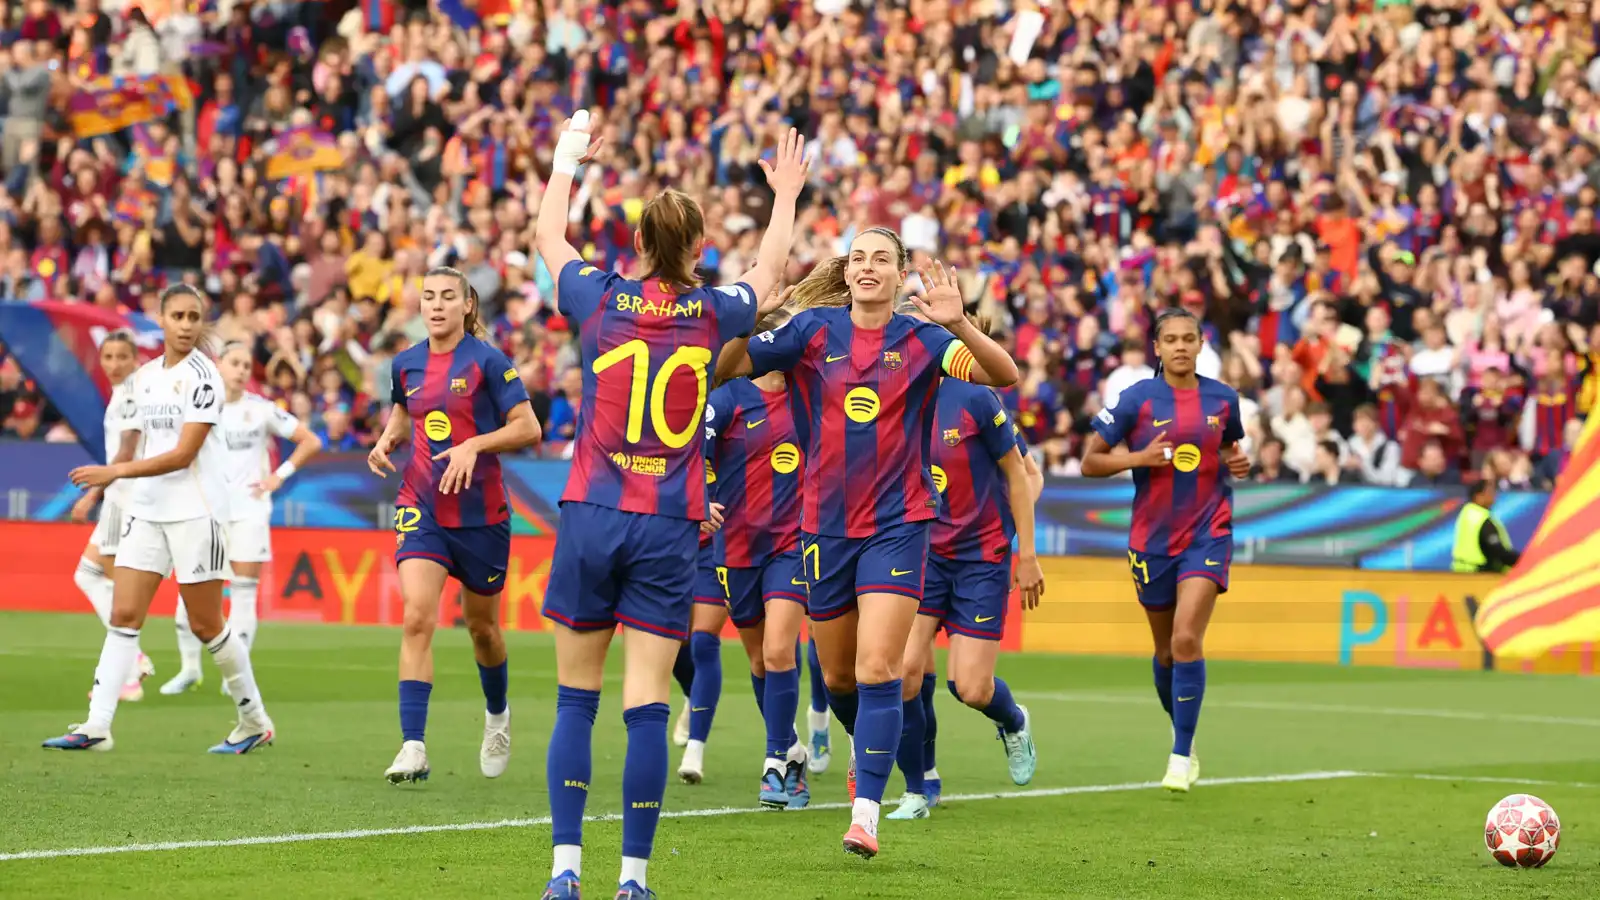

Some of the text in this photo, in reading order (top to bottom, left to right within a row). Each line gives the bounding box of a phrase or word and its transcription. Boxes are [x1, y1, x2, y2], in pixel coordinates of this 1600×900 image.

[592, 339, 713, 449] 10
[631, 464, 667, 474] ACNUR
[632, 455, 667, 466] UNHCR
[394, 507, 421, 532] 12
